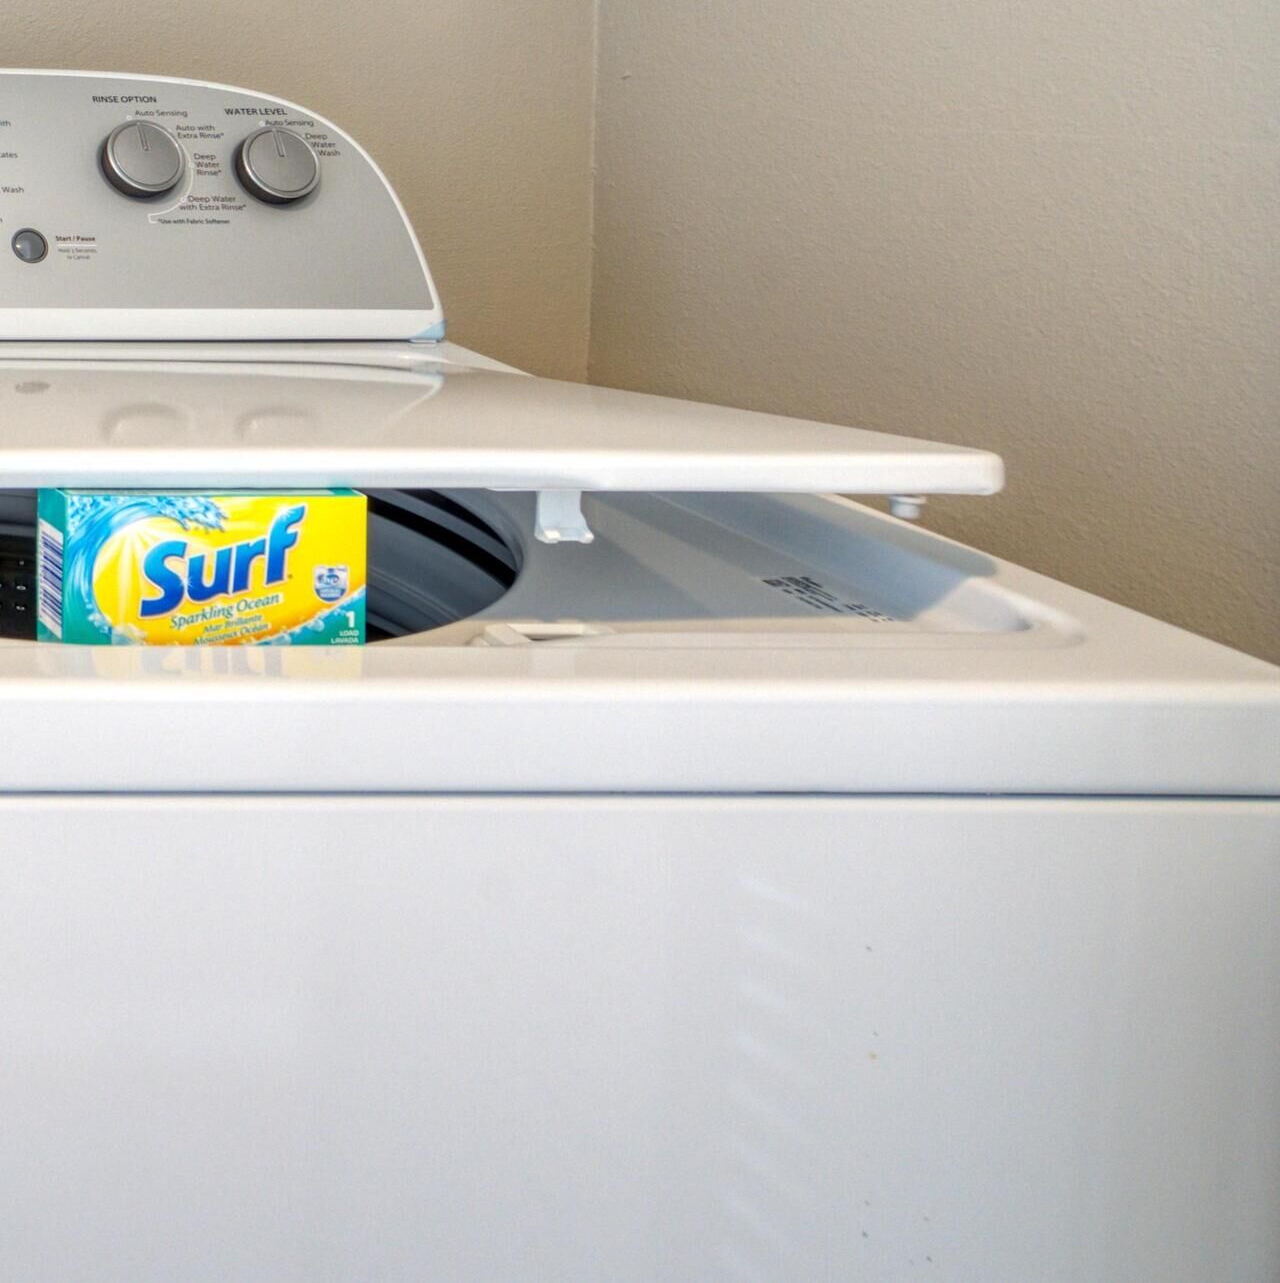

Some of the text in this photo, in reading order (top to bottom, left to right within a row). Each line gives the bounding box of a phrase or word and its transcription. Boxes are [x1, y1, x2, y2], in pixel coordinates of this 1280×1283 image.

[92, 96, 157, 104] RINSE OPTION
[156, 110, 188, 118] Sensing
[224, 108, 288, 116] WATER LEVEL
[2, 186, 24, 194] Wash
[139, 504, 307, 618] Surf
[170, 593, 280, 630] Sparkling Ocean
[346, 610, 355, 628] 1
